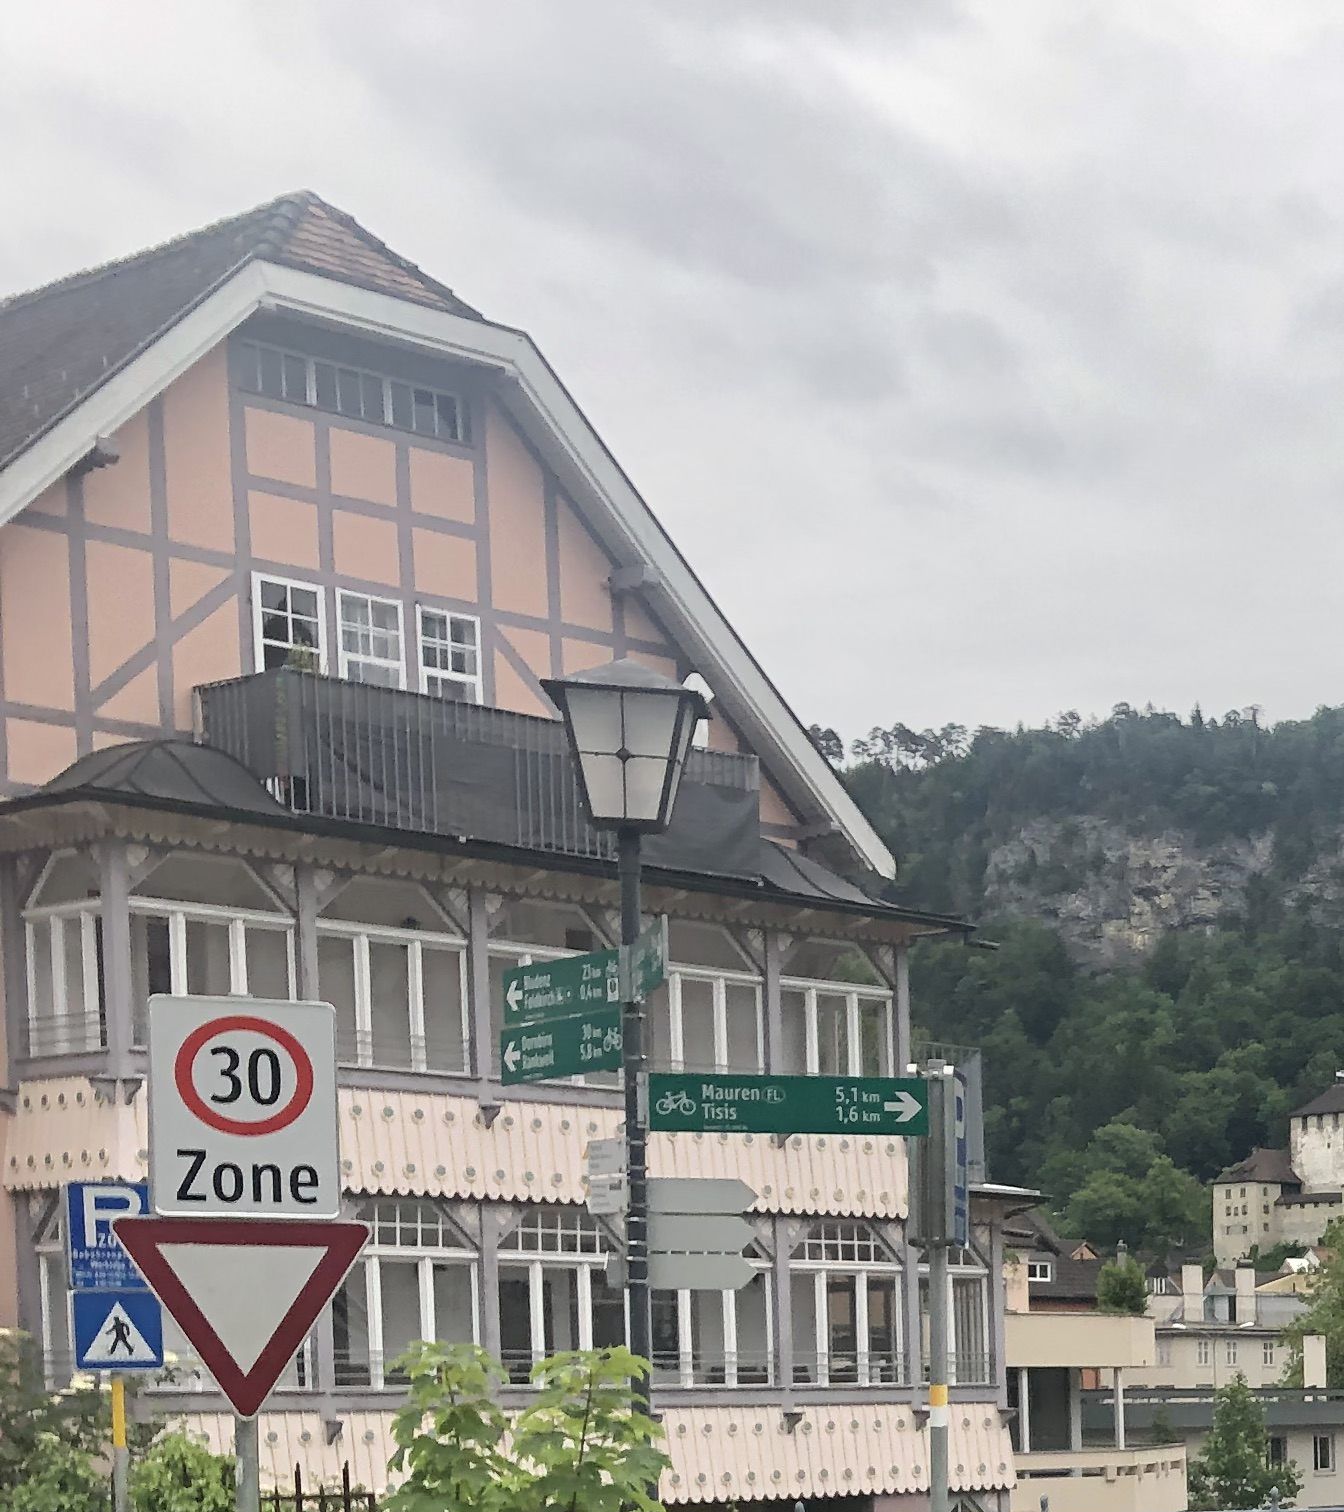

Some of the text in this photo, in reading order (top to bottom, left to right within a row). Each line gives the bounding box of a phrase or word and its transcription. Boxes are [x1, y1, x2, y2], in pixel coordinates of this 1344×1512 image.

[210, 1046, 281, 1105] 30
[701, 1084, 760, 1101] Mauren
[835, 1087, 858, 1104] 5,1
[861, 1091, 880, 1103] km
[701, 1102, 881, 1124] Tisis 1,6 km
[176, 1149, 319, 1203] Zone
[83, 1186, 142, 1248] P
